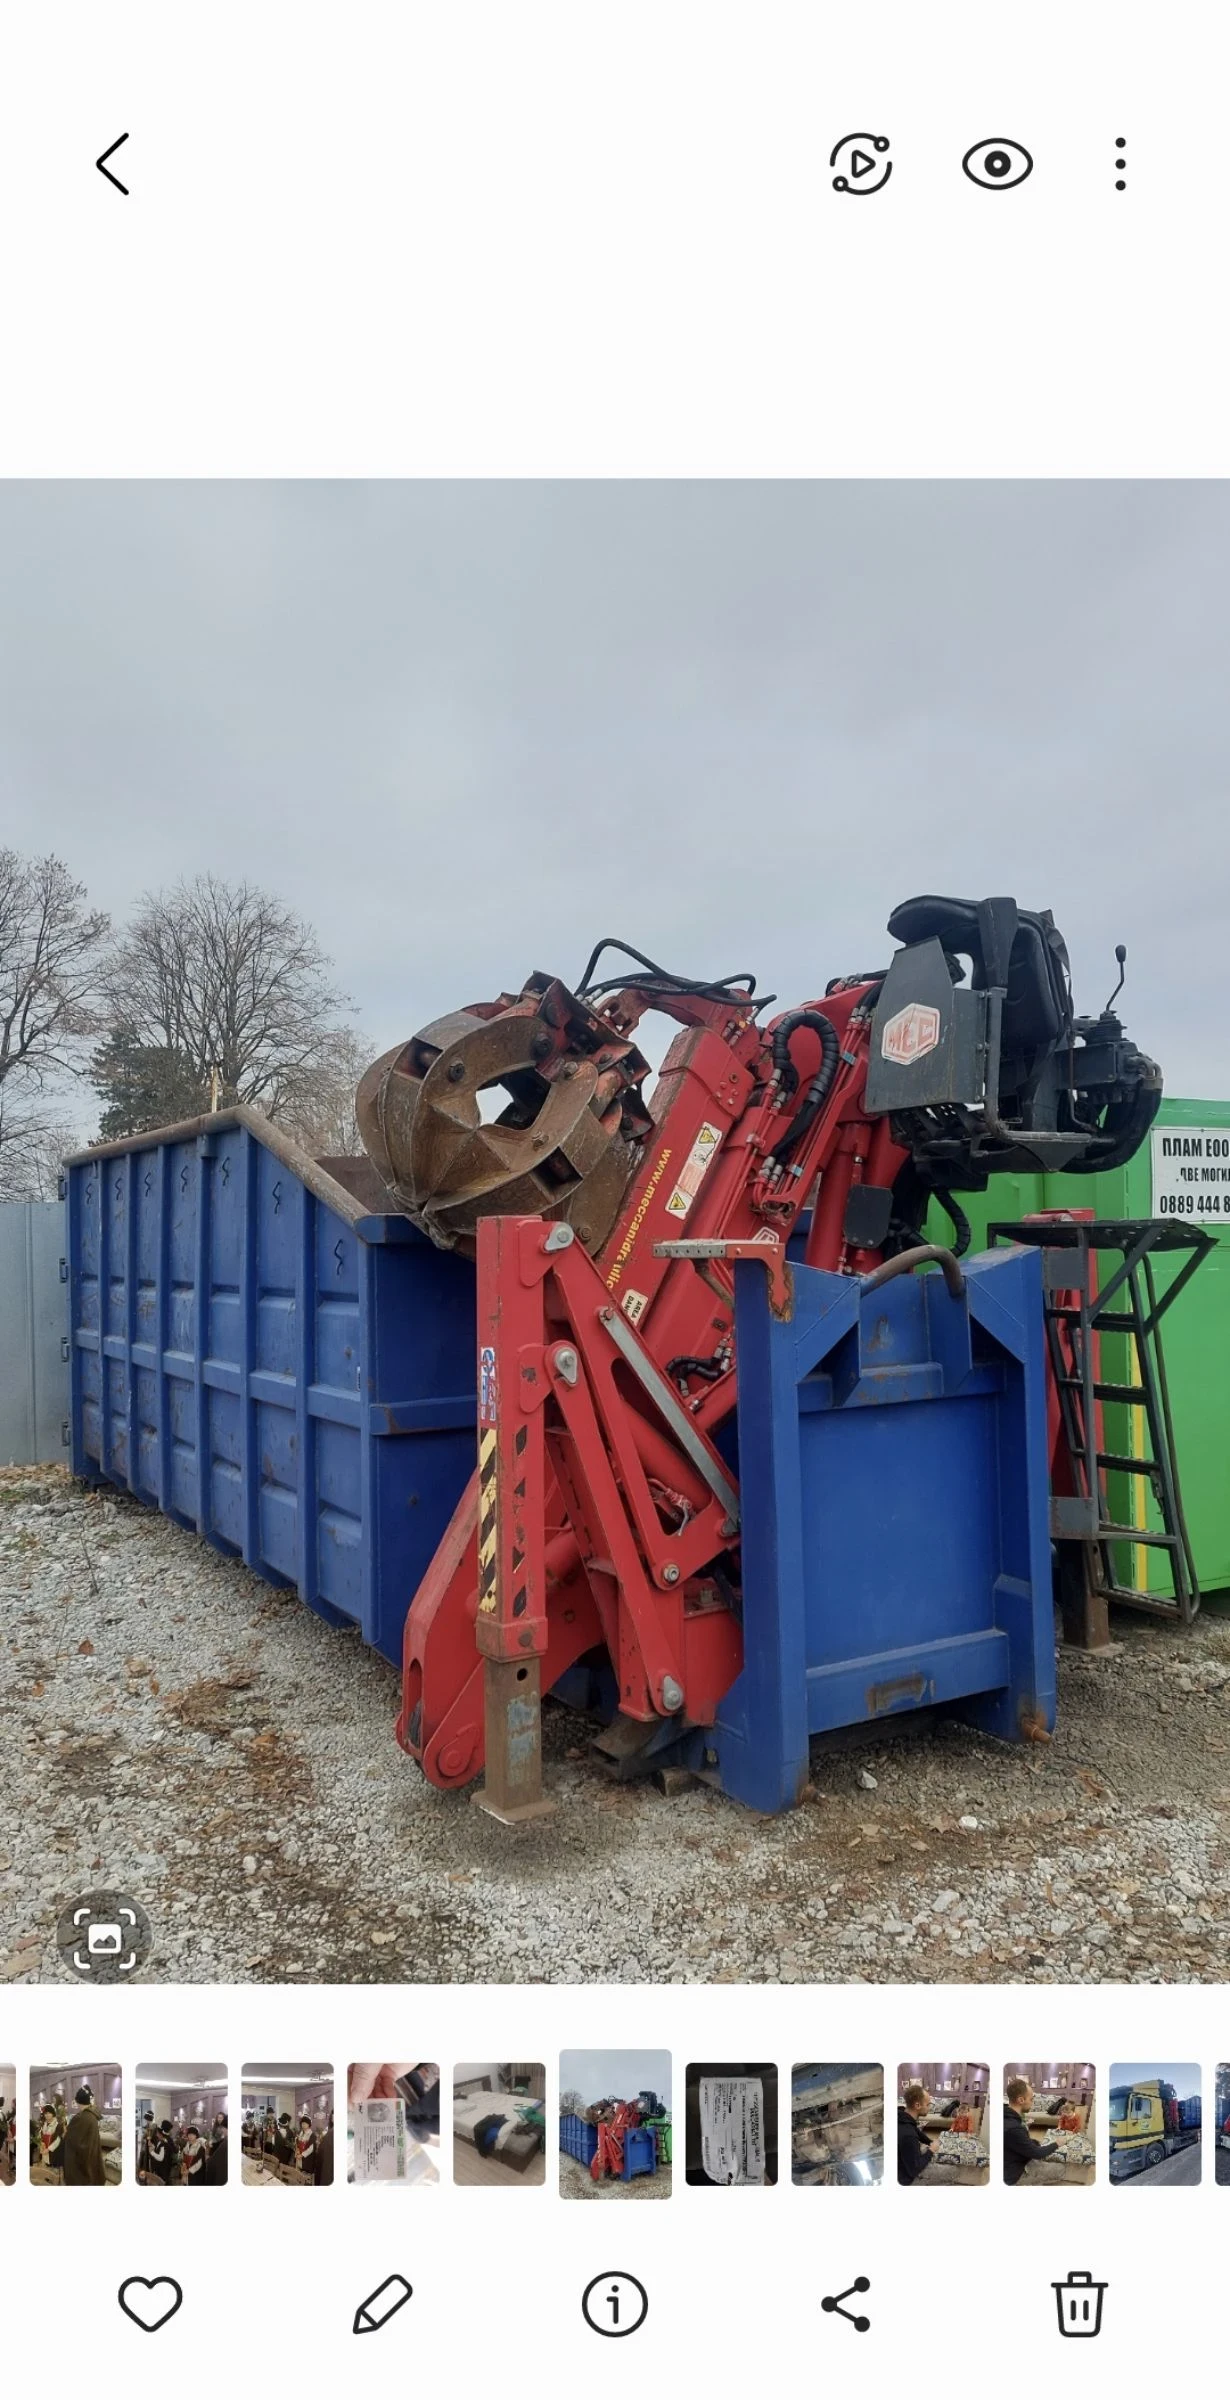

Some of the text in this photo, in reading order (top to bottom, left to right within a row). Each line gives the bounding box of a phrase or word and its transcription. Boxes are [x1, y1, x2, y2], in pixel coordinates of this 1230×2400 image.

[1163, 1138, 1229, 1157] ПЛАМ ЕОО
[1160, 1195, 1194, 1213] 0889
[1197, 1195, 1220, 1213] 444
